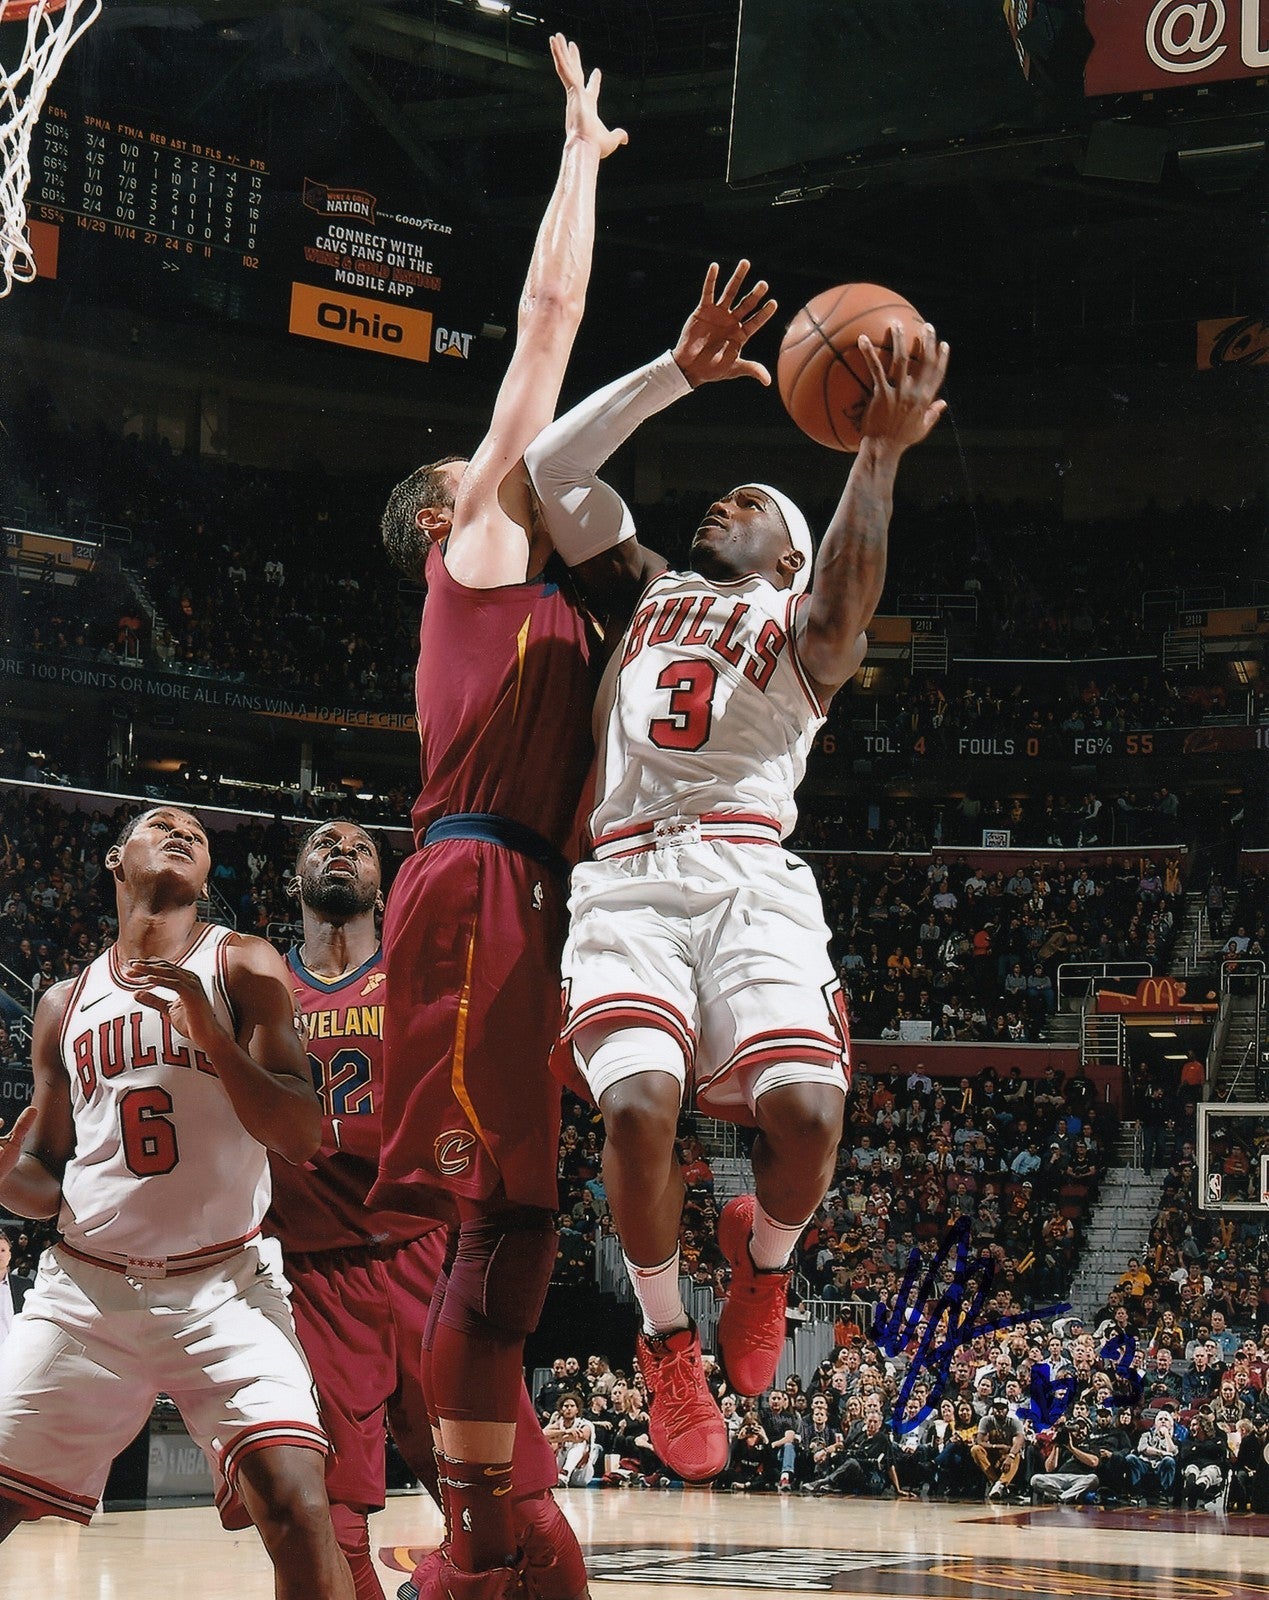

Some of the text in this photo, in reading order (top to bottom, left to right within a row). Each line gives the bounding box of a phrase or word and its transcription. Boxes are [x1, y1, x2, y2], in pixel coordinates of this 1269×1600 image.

[86, 133, 105, 149] 3/4
[120, 142, 139, 157] 0/0
[154, 152, 159, 163] 7
[174, 157, 181, 168] 2
[192, 162, 198, 173] 2
[209, 165, 215, 176] 2
[226, 172, 237, 183] -4
[252, 176, 261, 188] 13
[150, 133, 166, 146] REB
[171, 139, 186, 151] AST
[192, 143, 202, 154] TO
[205, 147, 221, 159] FLS
[250, 159, 265, 170] PTS
[86, 150, 104, 165] 4/5
[123, 160, 135, 173] 1/1
[172, 173, 181, 185] 10
[227, 186, 233, 198] 3
[249, 192, 262, 204] 27
[88, 167, 100, 181] 1/1
[119, 175, 137, 189] 7/8
[151, 184, 157, 195] 2
[172, 189, 179, 200] 2
[190, 193, 196, 204] 0
[225, 202, 232, 213] 6
[249, 208, 259, 220] 16
[83, 182, 103, 196] 0/0
[119, 190, 134, 204] 1/2
[150, 199, 157, 210] 3
[172, 204, 177, 215] 4
[225, 217, 231, 228] 3
[250, 223, 256, 234] 11
[83, 198, 101, 212] 2/4
[117, 206, 135, 220] 0/0
[149, 215, 156, 225] 2
[188, 224, 194, 235] 0
[205, 227, 211, 239] 0
[224, 232, 230, 243] 4
[248, 238, 255, 249] 8
[327, 201, 369, 216] NATION
[395, 214, 452, 234] GOODYEAR
[77, 216, 106, 232] 14/29
[114, 226, 135, 240] 11/14
[145, 233, 158, 245] 27
[165, 238, 179, 250] 24
[186, 242, 193, 254] 6
[204, 246, 211, 258] 11
[243, 256, 259, 269] 102
[316, 236, 433, 274] CAVS FANS ON THE
[328, 225, 423, 258] CONNECT WITH
[335, 269, 414, 297] MOBILE APP
[317, 302, 403, 344] Ohio
[435, 328, 473, 359] CAT
[620, 596, 787, 693] BULLS
[32, 663, 57, 679] 100
[61, 667, 117, 689] POINTS
[121, 676, 143, 693] OR
[147, 680, 190, 700] MORE
[194, 688, 219, 705] ALL
[225, 692, 261, 711] FANS
[265, 699, 294, 716] WIN
[334, 707, 374, 726] PIECE
[377, 712, 419, 729] CHIC
[648, 658, 719, 752] 3
[864, 736, 926, 754] TOL: 4
[959, 738, 1040, 756] FOULS 0
[1074, 734, 1153, 755] FG% 55
[73, 1011, 219, 1104] BULL
[120, 1085, 180, 1177] 6
